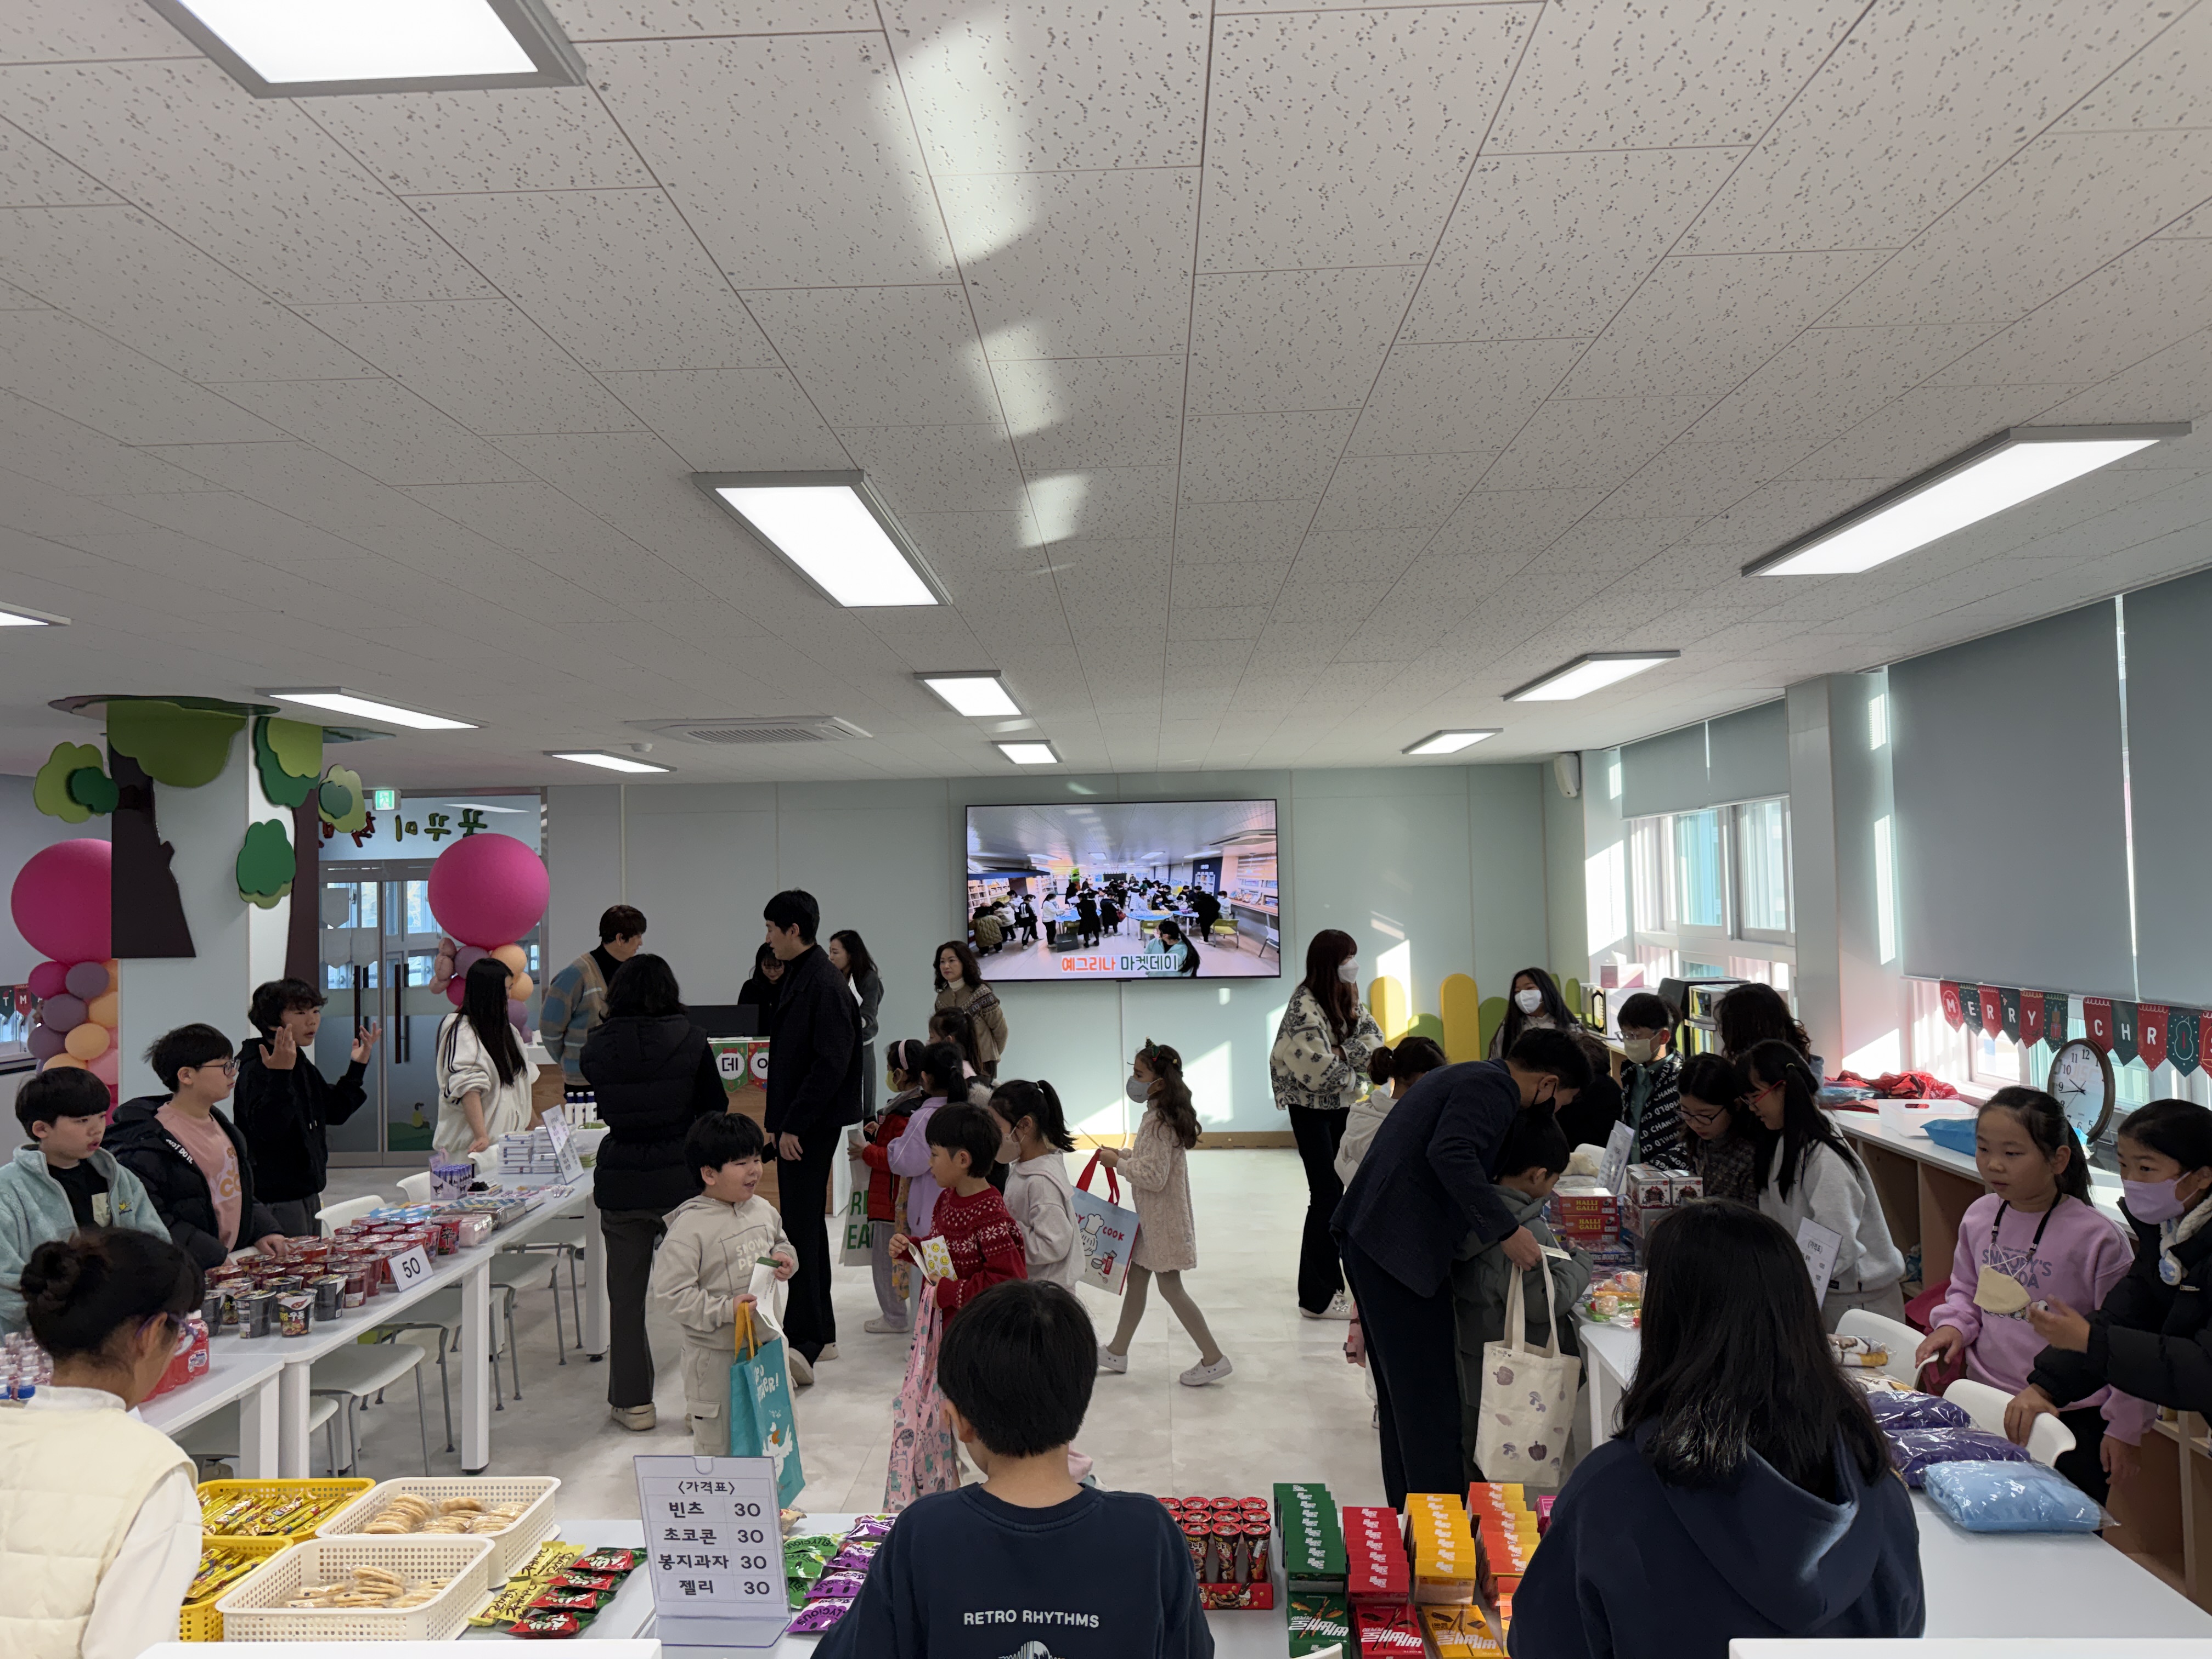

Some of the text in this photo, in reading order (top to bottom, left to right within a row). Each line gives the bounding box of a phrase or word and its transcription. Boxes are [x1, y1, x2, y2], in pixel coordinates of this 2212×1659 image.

[1062, 955, 1177, 971] 예그리나 마켓데이
[1946, 998, 2036, 1027] MERRY
[2071, 1053, 2078, 1063] 11
[2082, 1049, 2090, 1059] 12
[2063, 1065, 2071, 1075] 10
[2058, 1082, 2063, 1091] 9
[441, 1227, 456, 1246] 辛
[1103, 1226, 1125, 1241] COOK
[402, 1257, 421, 1279] 50
[669, 1502, 761, 1518] 빈츠 30
[664, 1527, 764, 1545] 초코콘 30
[658, 1554, 767, 1571] 봉지과자 30
[679, 1579, 770, 1595] 젤리 30
[963, 1610, 1100, 1628] RETRO RHYTHMS
[1288, 1618, 1349, 1637] 빼빼로
[1361, 1629, 1423, 1647] 빼빼로
[1436, 1632, 1497, 1650] 빼빼로
